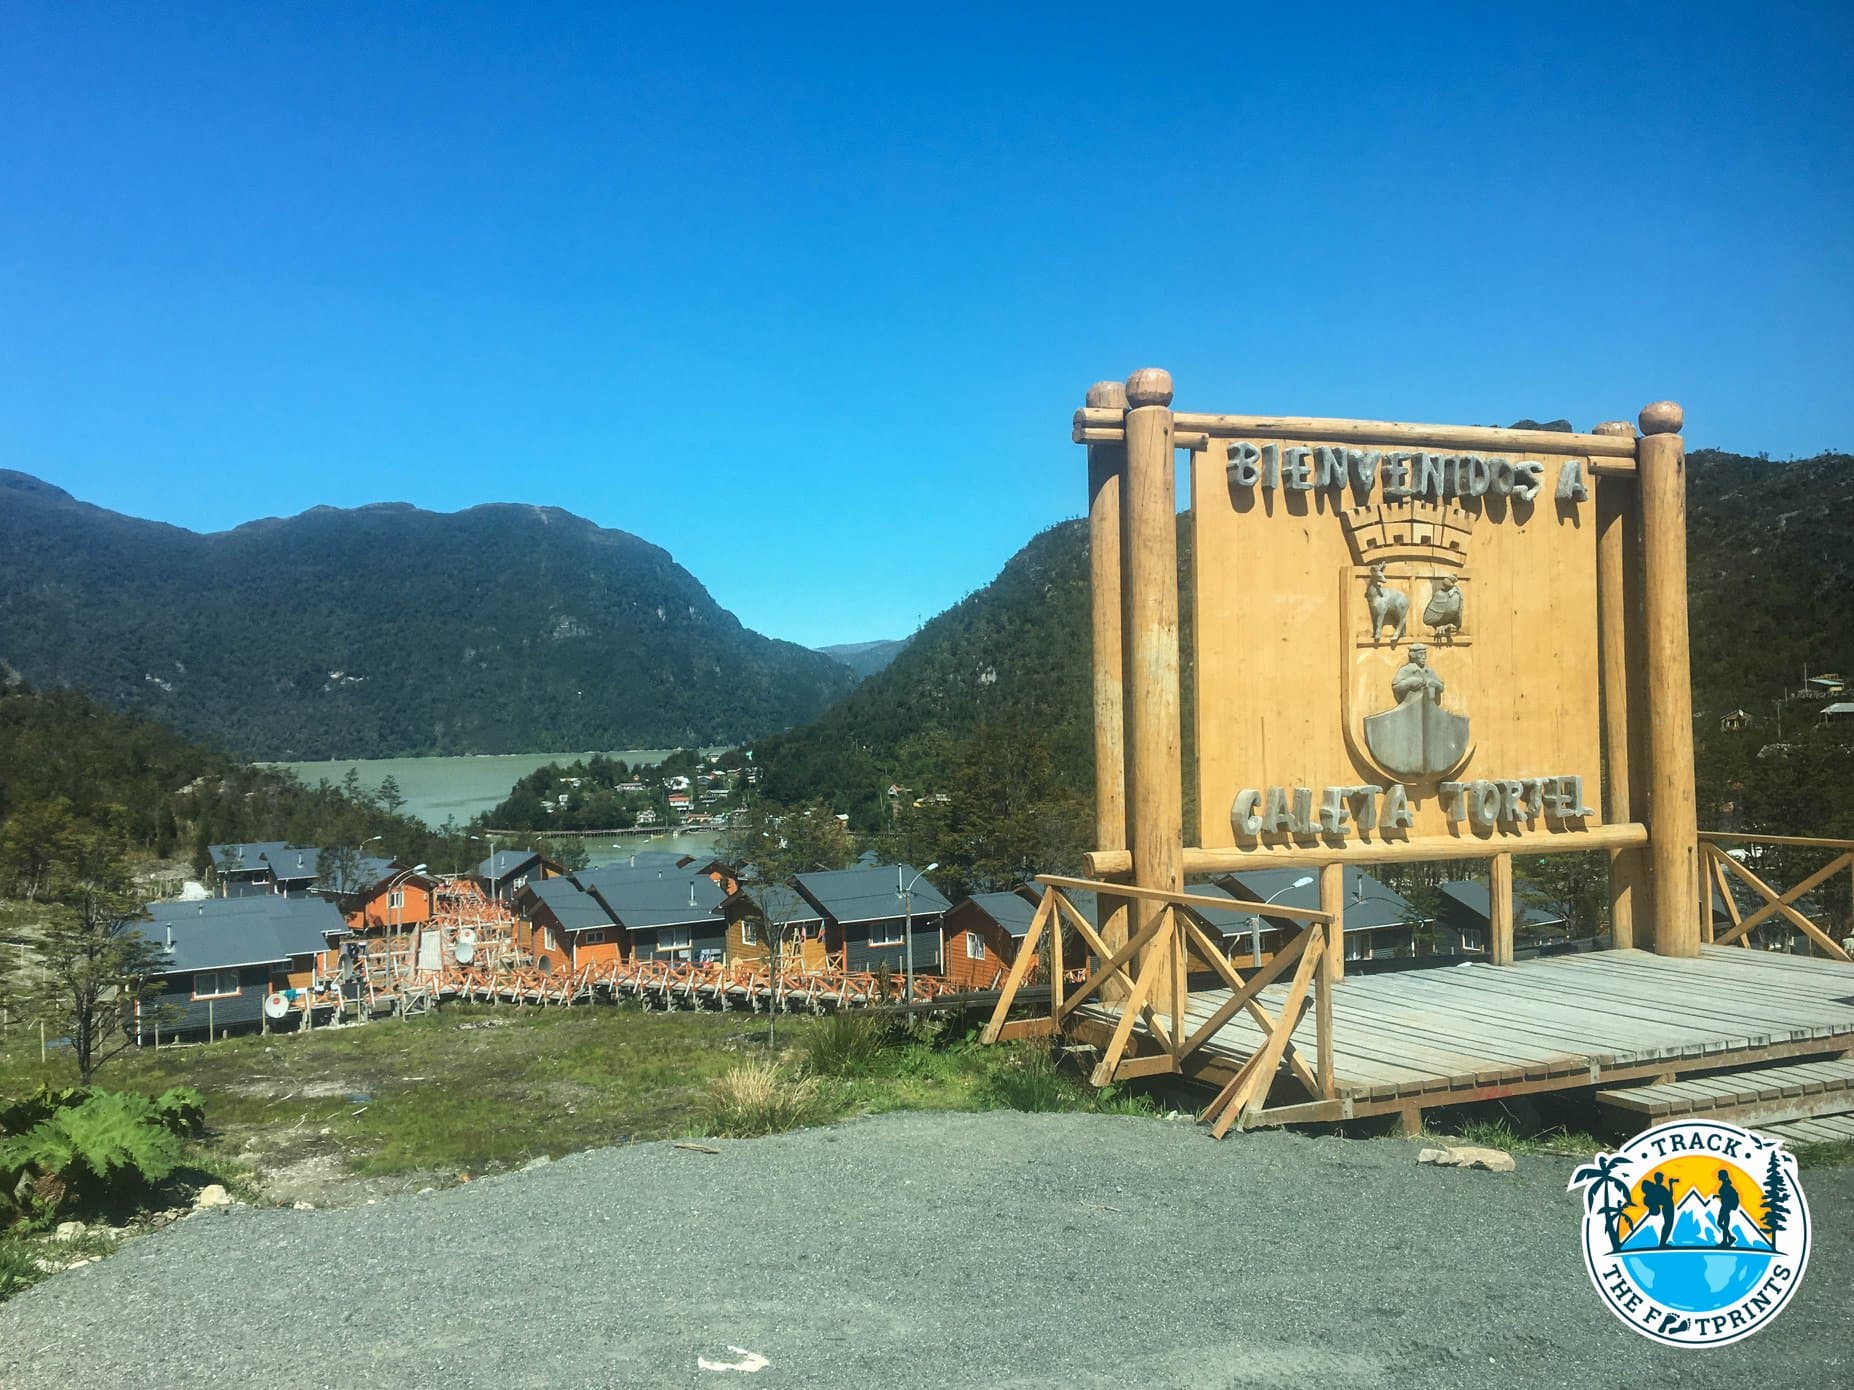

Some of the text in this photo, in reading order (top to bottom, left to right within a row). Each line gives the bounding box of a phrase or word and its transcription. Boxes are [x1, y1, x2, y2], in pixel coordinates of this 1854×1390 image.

[1226, 441, 1589, 502] BIENVENIDOS A
[1231, 775, 1594, 836] CALETA TORTEL
